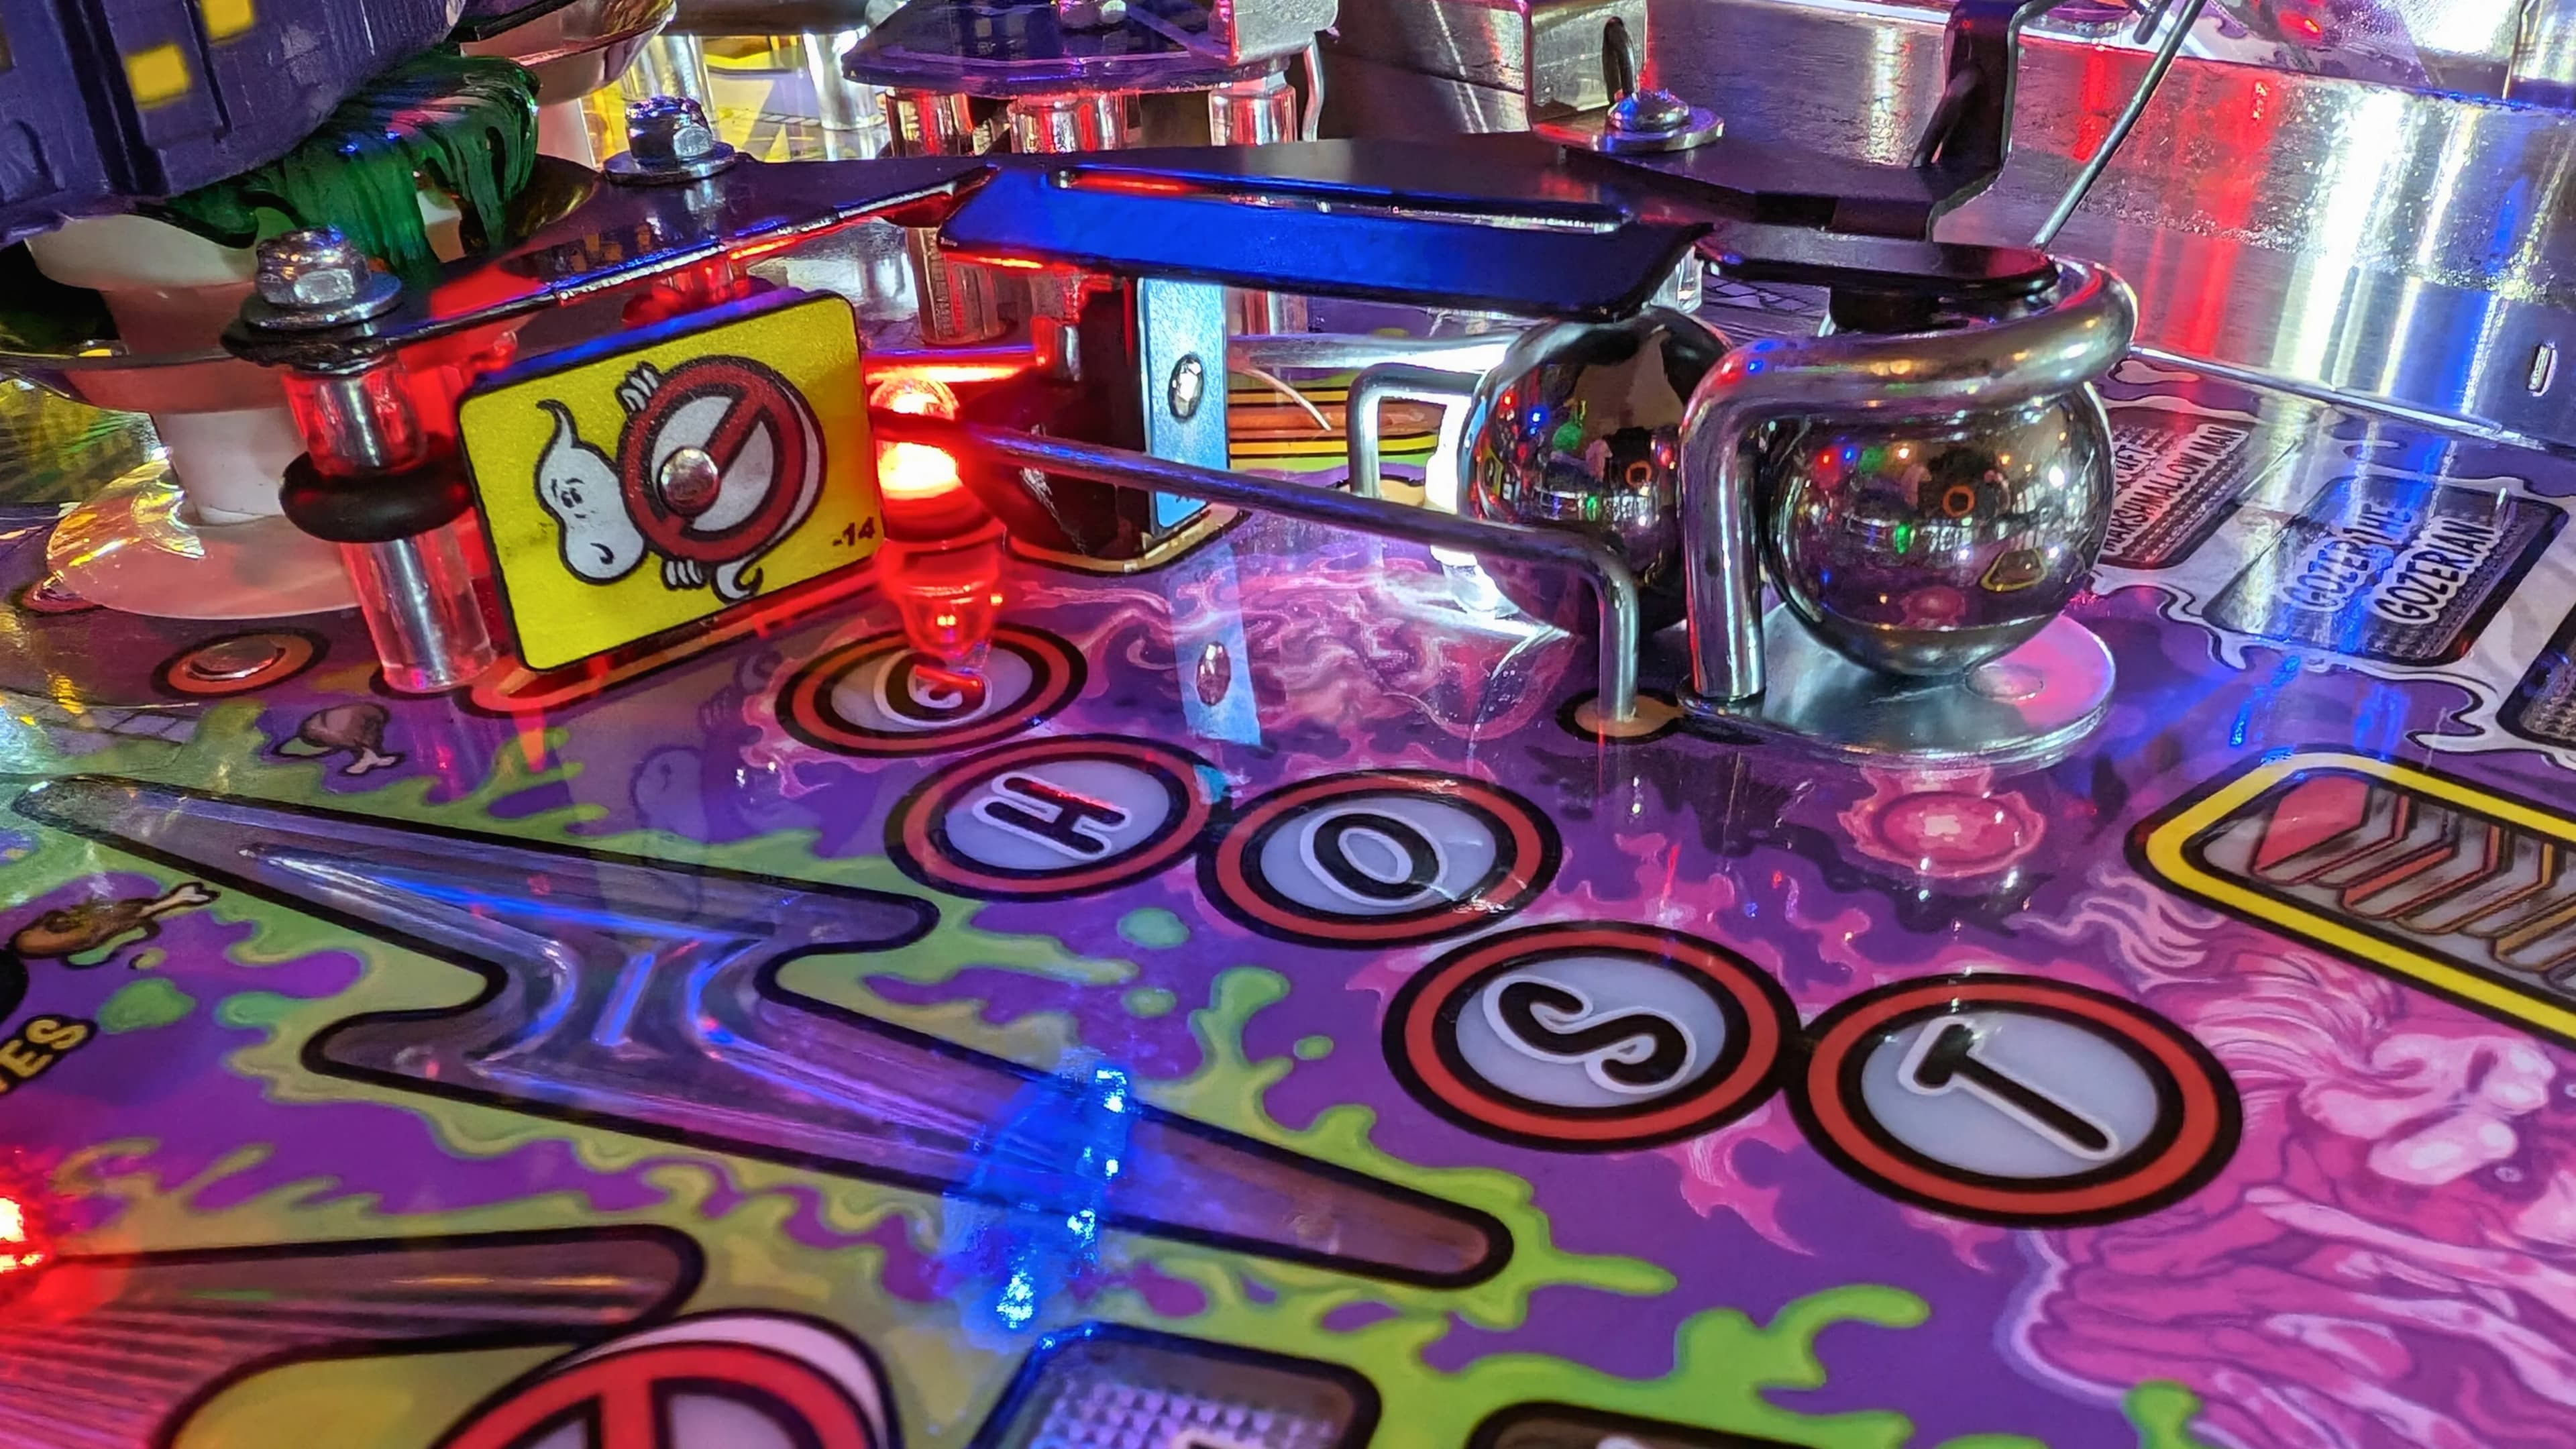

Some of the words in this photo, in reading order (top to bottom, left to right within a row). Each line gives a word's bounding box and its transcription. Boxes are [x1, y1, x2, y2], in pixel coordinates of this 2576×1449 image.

[2188, 426, 2243, 457] MAN
[832, 516, 875, 547] -14
[2283, 539, 2385, 607] GOZER
[2374, 520, 2496, 620] GOZERIAN
